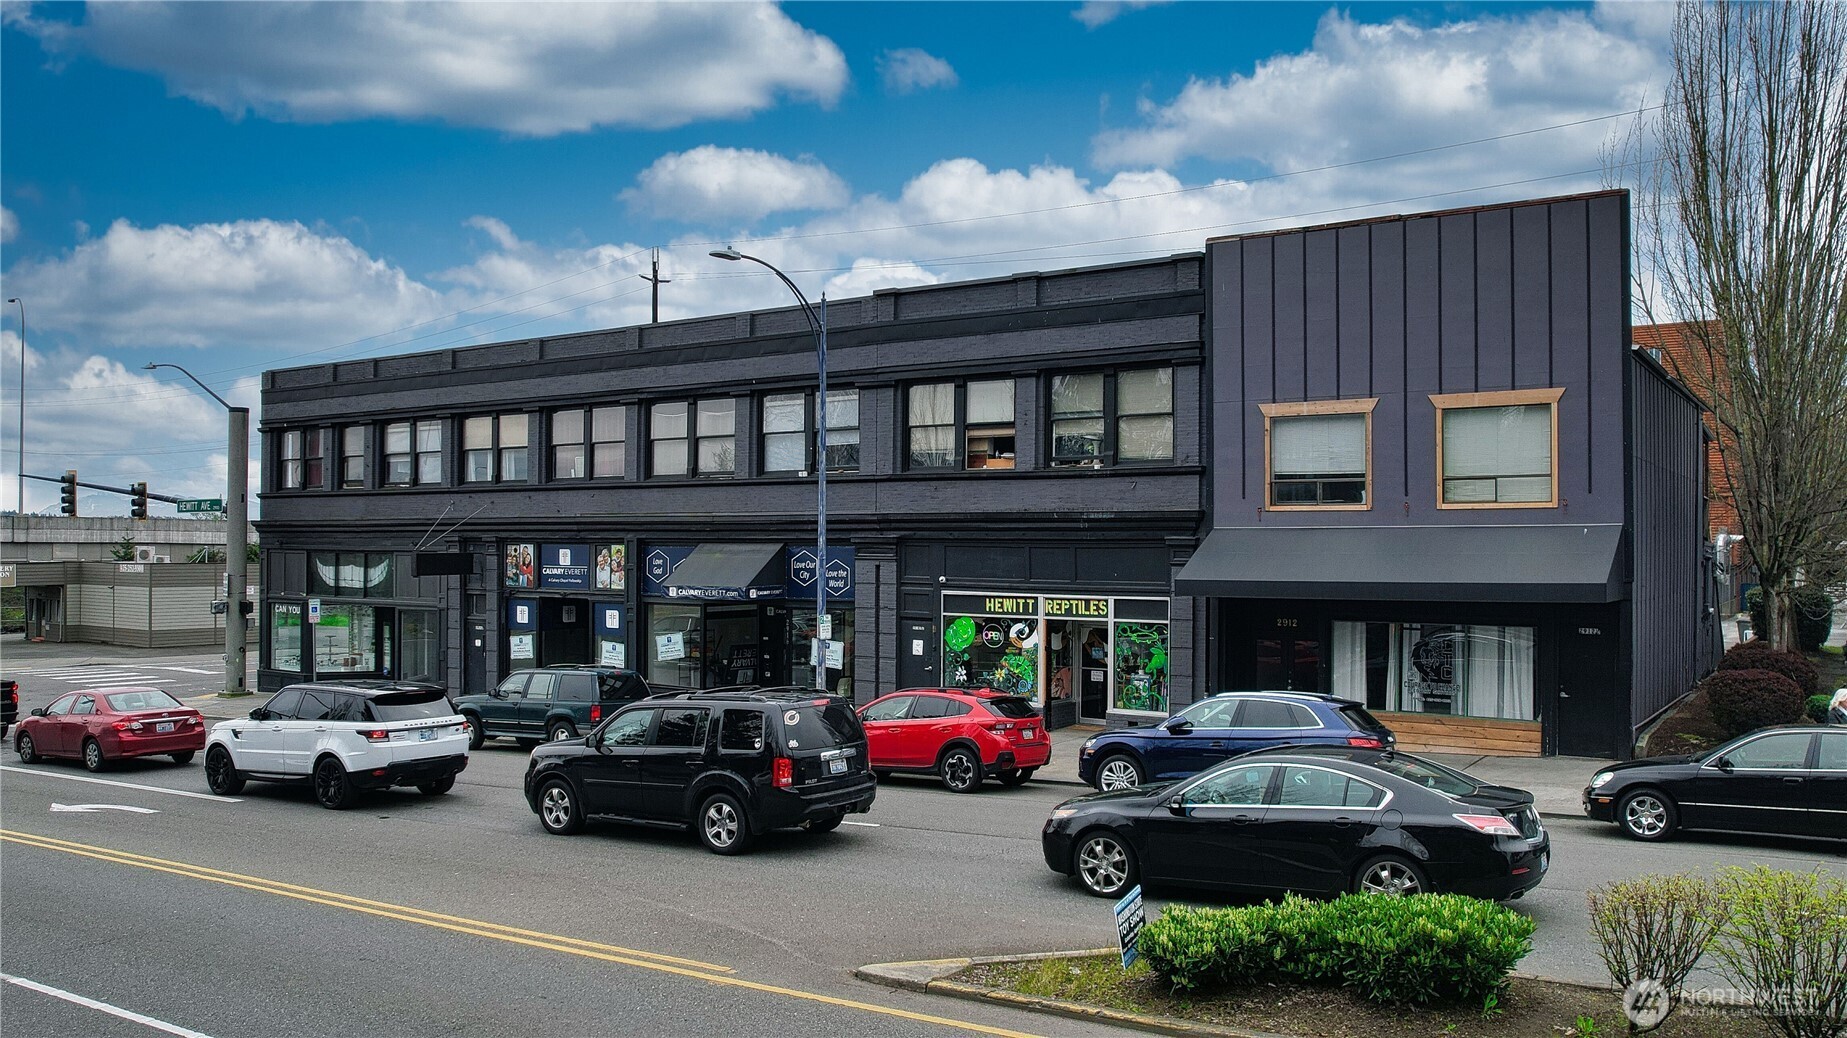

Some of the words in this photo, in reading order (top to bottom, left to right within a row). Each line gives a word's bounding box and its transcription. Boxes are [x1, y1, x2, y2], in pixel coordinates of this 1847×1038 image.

[179, 501, 198, 511] HEWITT
[200, 501, 211, 511] AVE
[652, 558, 663, 566] Love
[794, 561, 805, 569] Love
[805, 561, 816, 569] Our
[653, 567, 663, 575] God
[799, 570, 810, 580] City
[825, 569, 838, 577] Love
[838, 569, 847, 577] the
[828, 579, 845, 588] World
[274, 604, 287, 613] CAN
[288, 605, 301, 614] YOU
[985, 598, 1035, 613] HEWITT
[1045, 600, 1108, 615] REPTILES
[1276, 618, 1298, 627] 2912
[983, 630, 1004, 641] OPEN
[1119, 920, 1130, 937] TOY
[1129, 906, 1144, 928] SHOW
